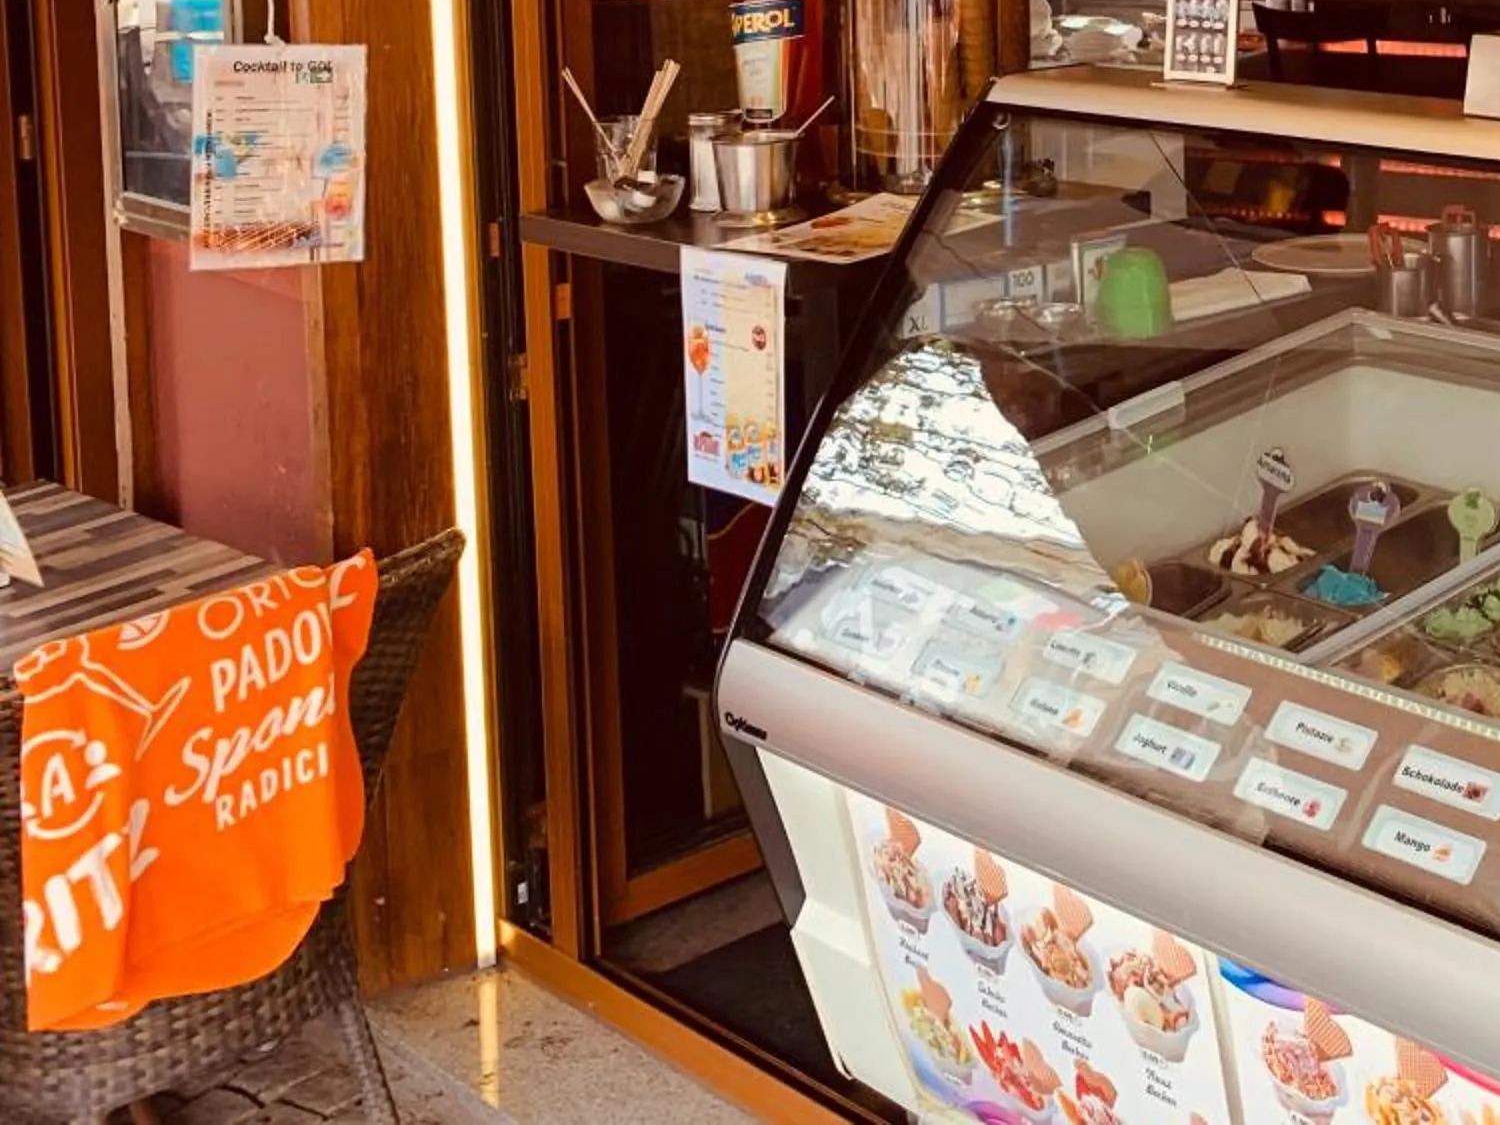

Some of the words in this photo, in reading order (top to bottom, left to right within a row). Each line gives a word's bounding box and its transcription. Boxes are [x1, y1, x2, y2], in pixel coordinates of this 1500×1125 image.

[233, 59, 287, 74] Cocktail
[215, 742, 329, 831] RADICI
[1400, 765, 1465, 795] Schokolade
[1393, 830, 1431, 854] Mango
